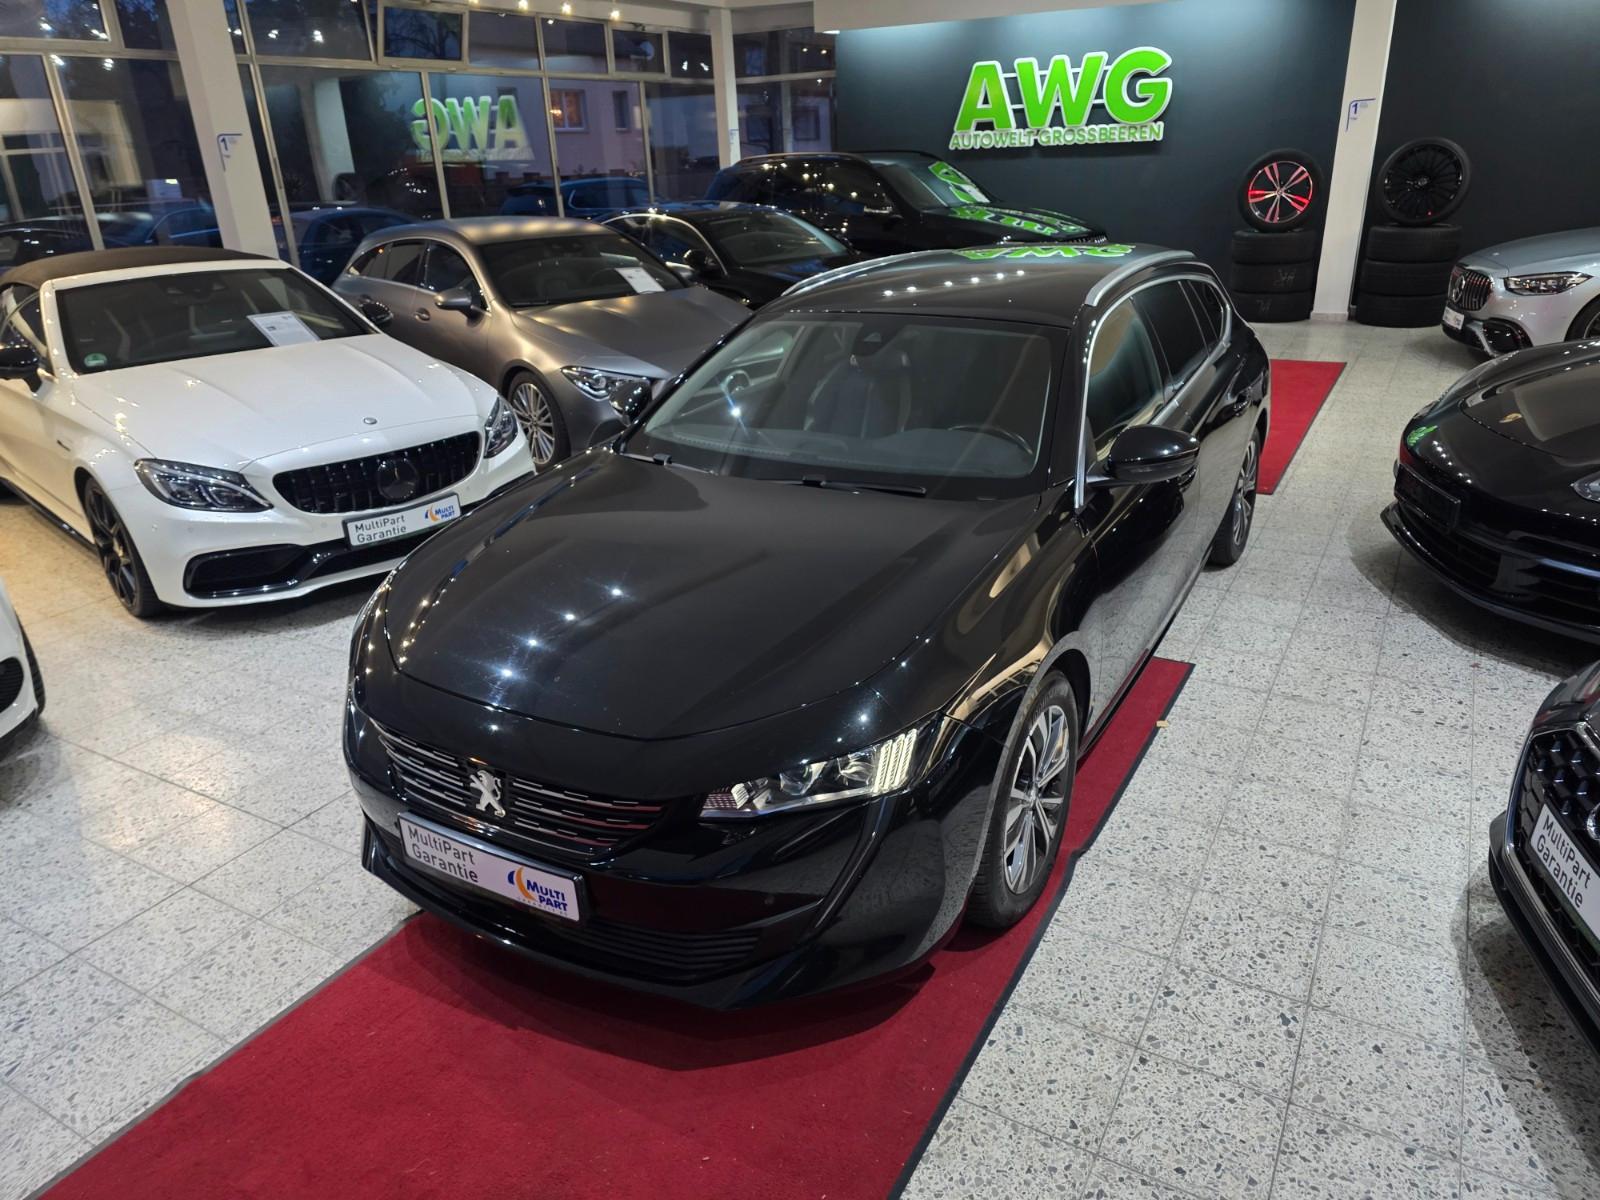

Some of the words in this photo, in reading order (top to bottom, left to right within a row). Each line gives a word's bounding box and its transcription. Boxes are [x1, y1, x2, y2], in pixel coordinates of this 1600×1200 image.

[954, 46, 1173, 133] AWG
[355, 515, 405, 533] MultiPart
[357, 526, 407, 543] Garantie
[408, 825, 475, 865] MultiPart
[411, 843, 479, 883] Garantie
[1543, 815, 1591, 889] MultiPart
[526, 879, 566, 902] MULTI
[1536, 834, 1583, 908] Garantie
[538, 895, 568, 912] PART
